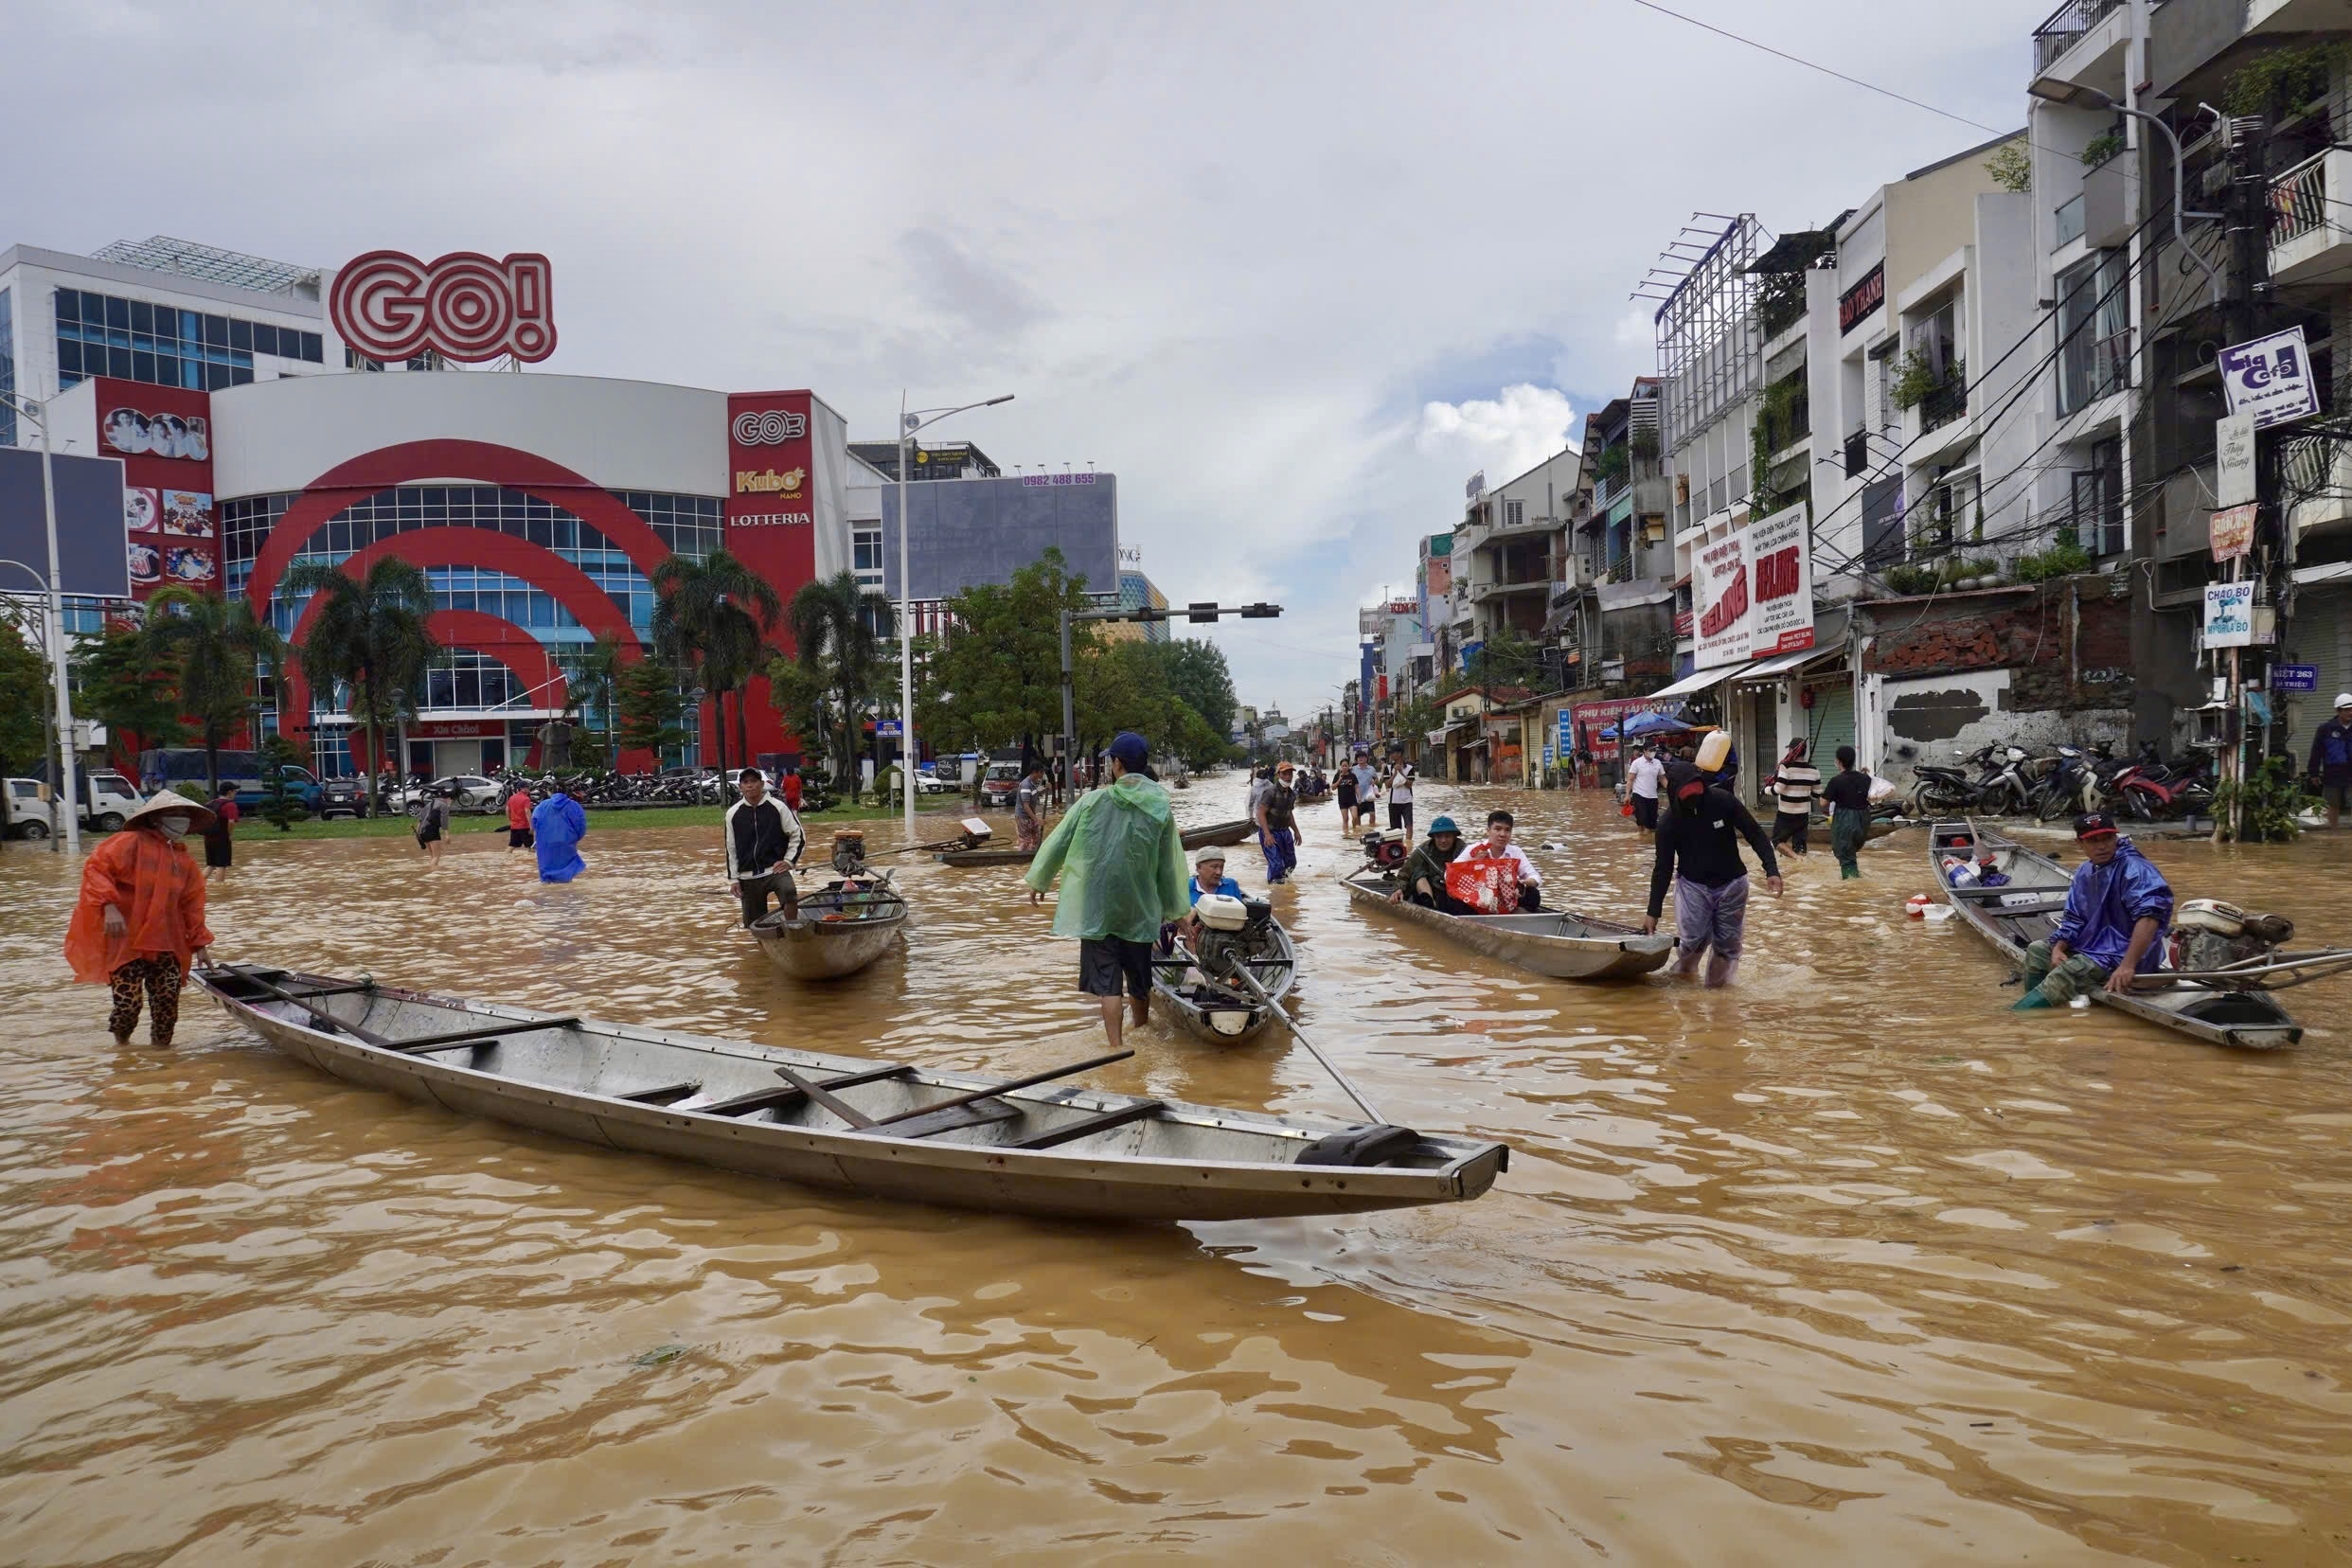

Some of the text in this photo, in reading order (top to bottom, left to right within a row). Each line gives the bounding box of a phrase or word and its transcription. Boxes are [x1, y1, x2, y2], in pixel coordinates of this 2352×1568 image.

[330, 250, 558, 363] GO!
[736, 469, 801, 492] Kubo
[1024, 473, 1094, 486] 0982 488 655
[730, 512, 811, 526] LOTTERIA
[2296, 669, 2313, 679] 263
